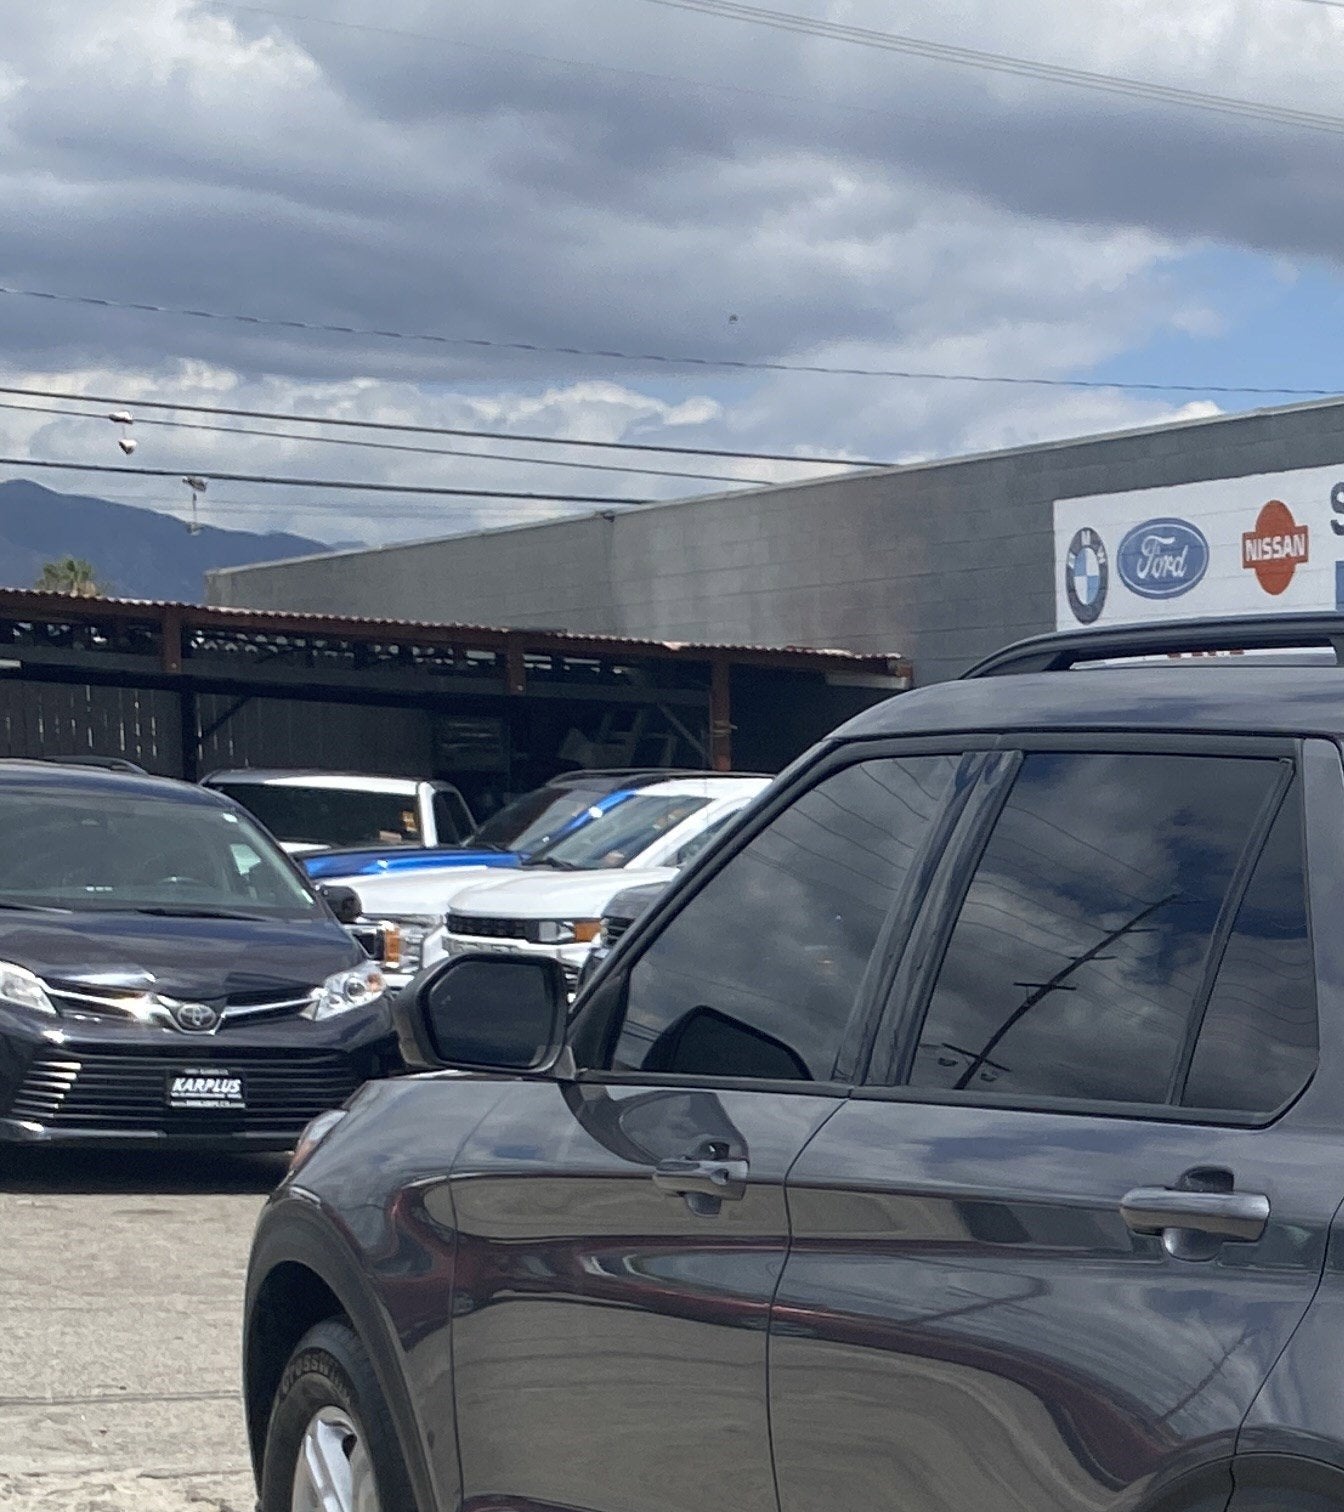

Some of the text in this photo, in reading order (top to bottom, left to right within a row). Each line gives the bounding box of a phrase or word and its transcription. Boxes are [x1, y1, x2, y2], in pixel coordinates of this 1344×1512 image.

[1137, 535, 1188, 579] Ford
[1245, 533, 1305, 563] NISSAN
[172, 1077, 242, 1093] KARPLUS
